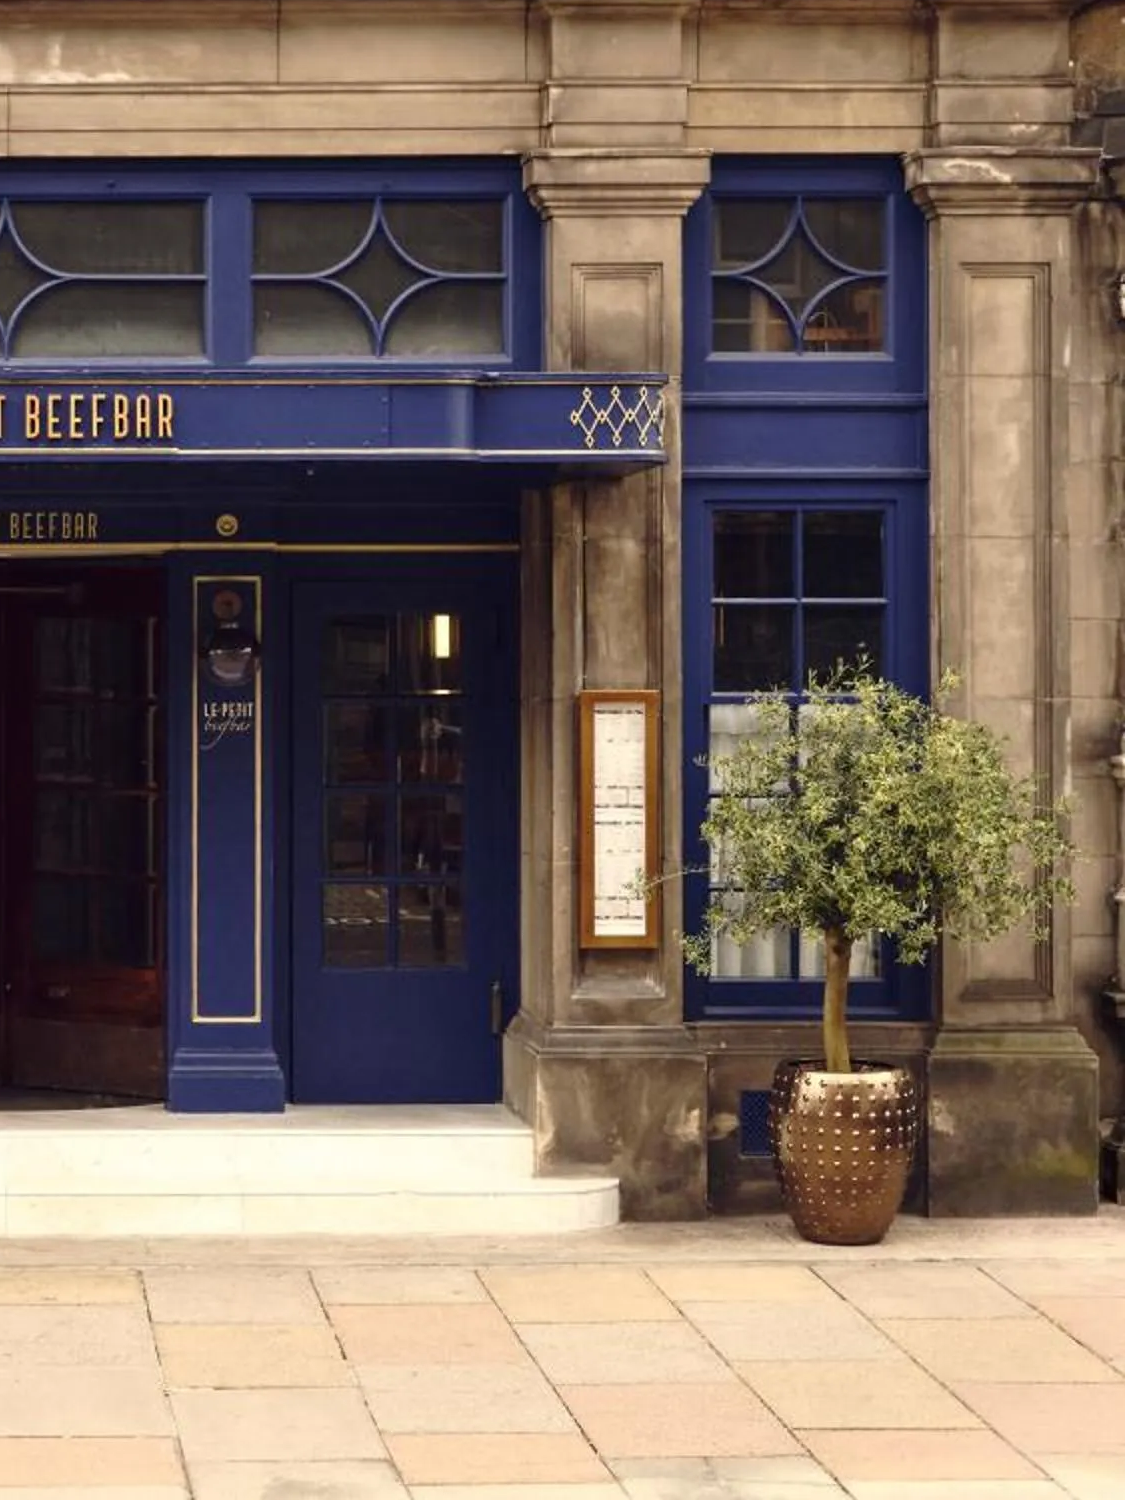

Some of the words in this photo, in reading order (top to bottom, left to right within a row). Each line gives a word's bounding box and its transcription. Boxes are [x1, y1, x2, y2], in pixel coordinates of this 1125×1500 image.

[26, 393, 173, 439] BEEFBAR
[10, 512, 99, 539] BEEFBAR
[204, 703, 218, 717] LE
[222, 703, 253, 717] PETIT
